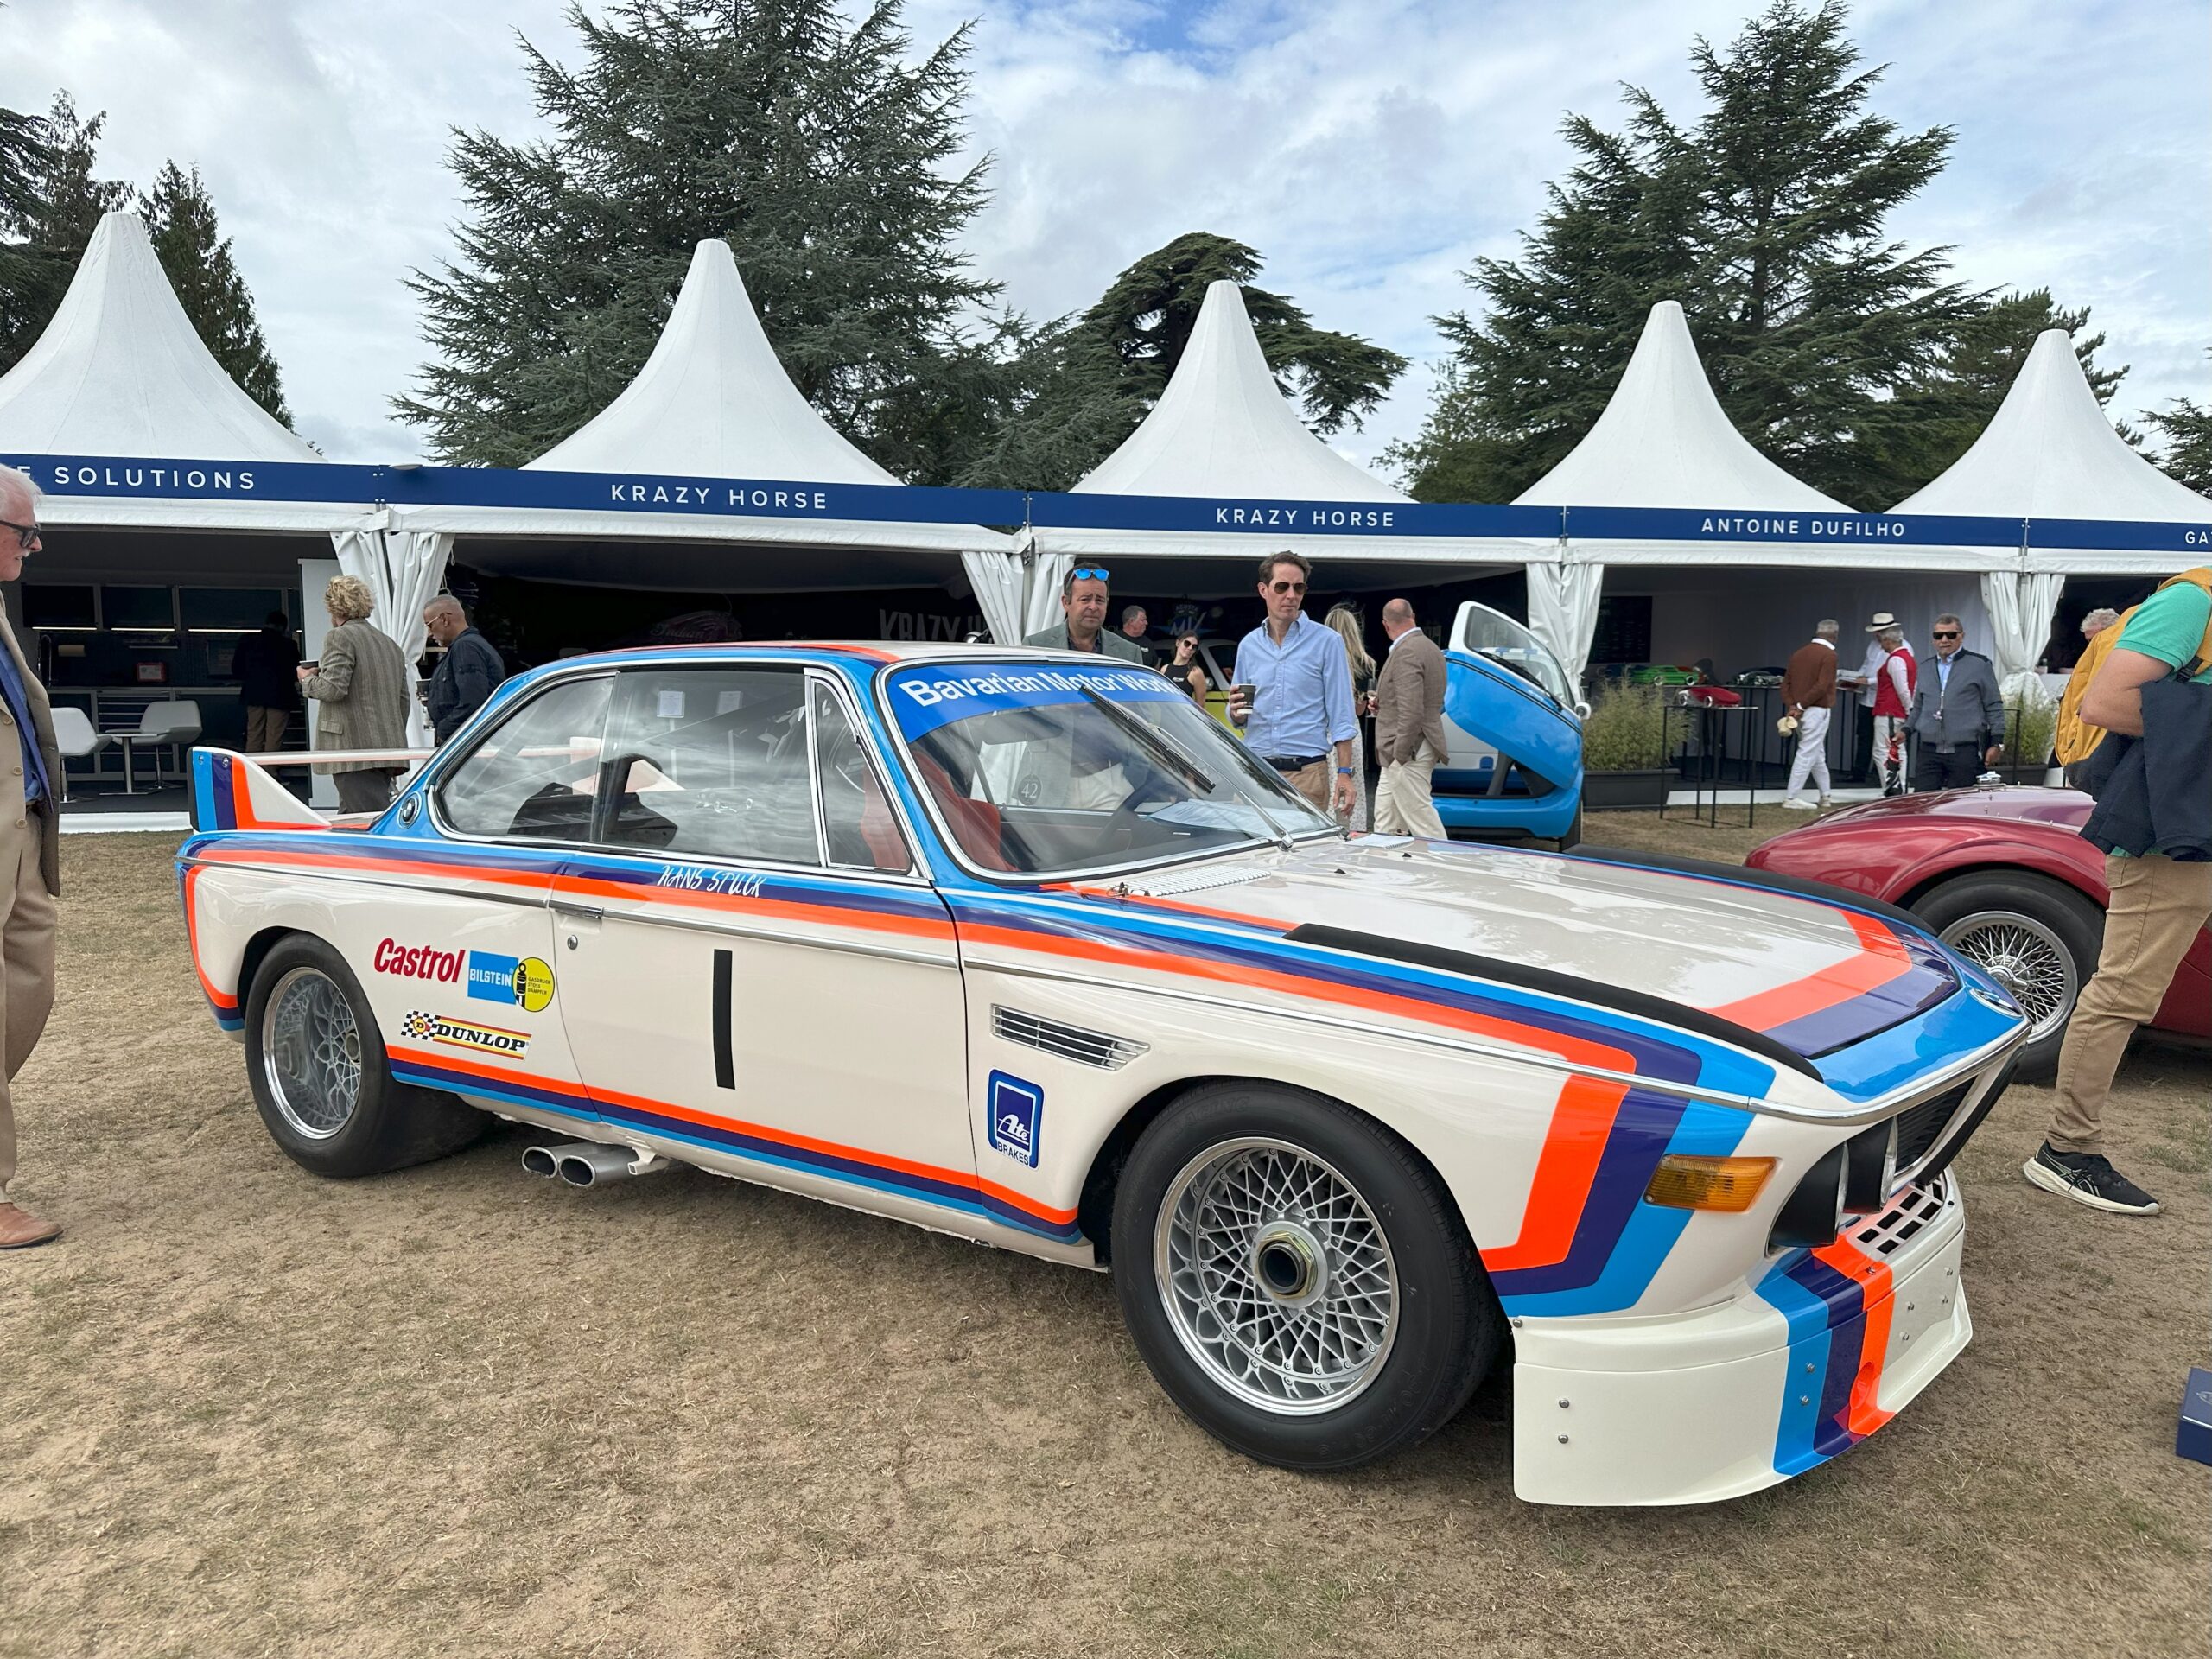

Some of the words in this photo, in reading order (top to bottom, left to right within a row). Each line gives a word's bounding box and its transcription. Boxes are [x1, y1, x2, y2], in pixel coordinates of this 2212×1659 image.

[54, 467, 254, 490] SOLUTIONS
[611, 484, 710, 505] KRAZY
[729, 489, 827, 510] HORSE
[1217, 508, 1299, 524] KRAZY
[1313, 511, 1394, 527] HORSE
[1701, 518, 1800, 534] ANTOINE
[1811, 520, 1905, 537] DUFILHO
[2184, 531, 2212, 544] GA
[899, 672, 1043, 707] Bavarian
[1036, 671, 1124, 691] Motor
[1020, 782, 1039, 798] 42
[657, 864, 706, 890] HANS
[373, 938, 467, 983] Castrol
[469, 968, 512, 988] BILSTEIN
[436, 1023, 526, 1052] DUNLOP
[998, 1113, 1030, 1141] Ate
[997, 1141, 1029, 1166] BRAKES
